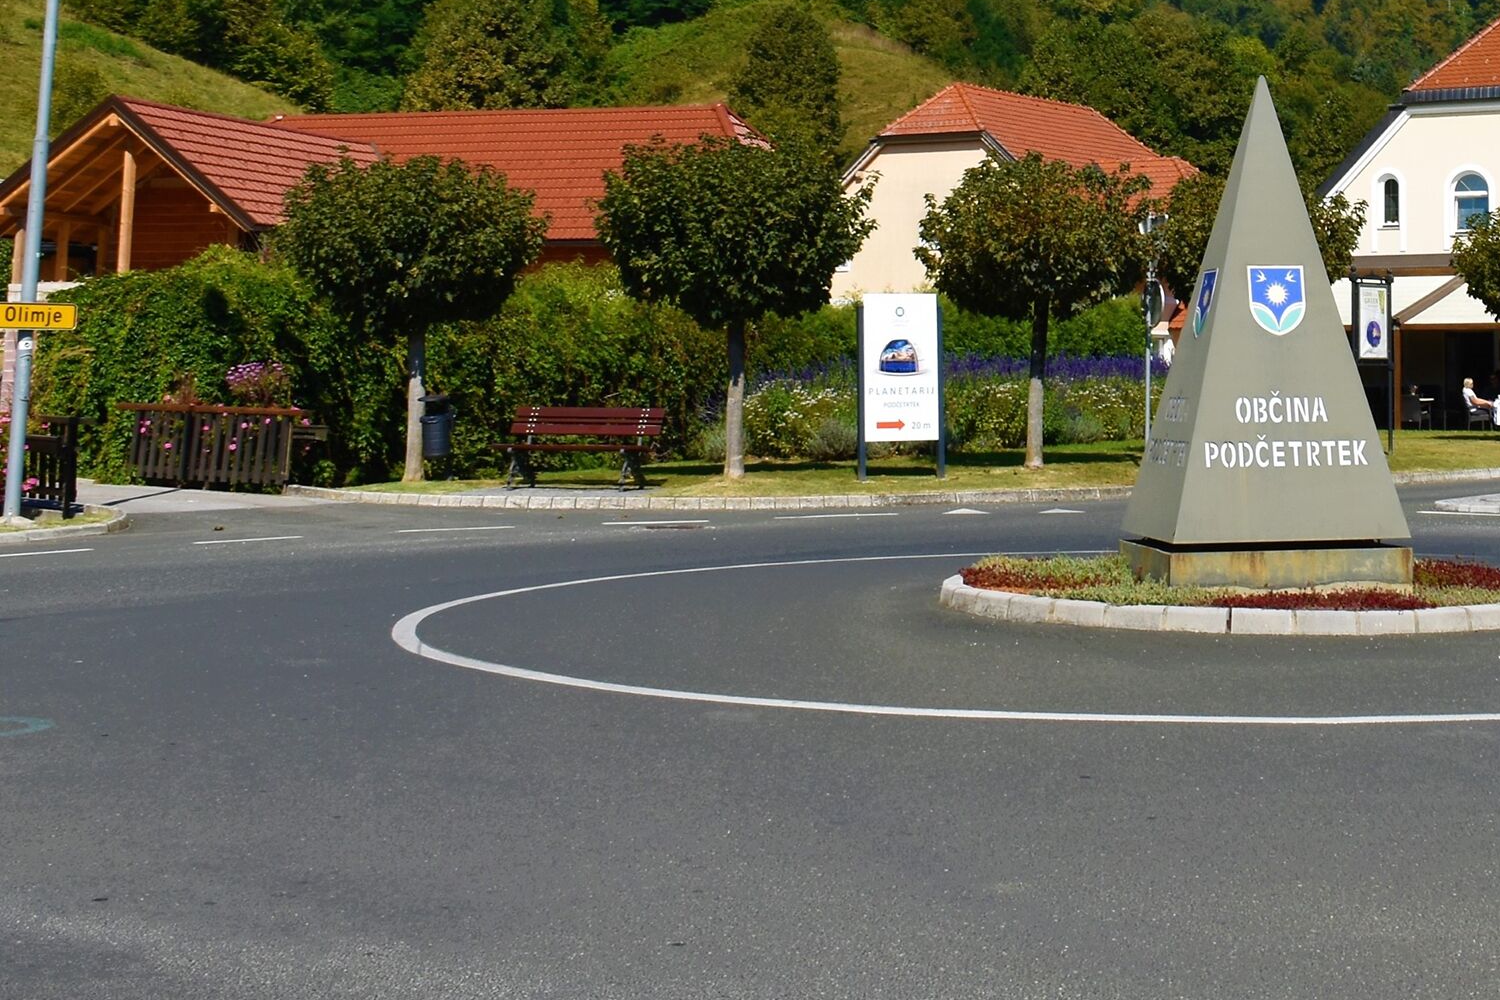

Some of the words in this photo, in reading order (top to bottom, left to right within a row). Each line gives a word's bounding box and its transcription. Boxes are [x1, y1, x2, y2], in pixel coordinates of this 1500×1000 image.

[5, 305, 62, 326] Olimje
[868, 387, 935, 396] PLANETARIJ
[1235, 390, 1328, 424] OBČINA
[911, 421, 921, 430] 20
[1204, 434, 1368, 468] PODČETRTEK
